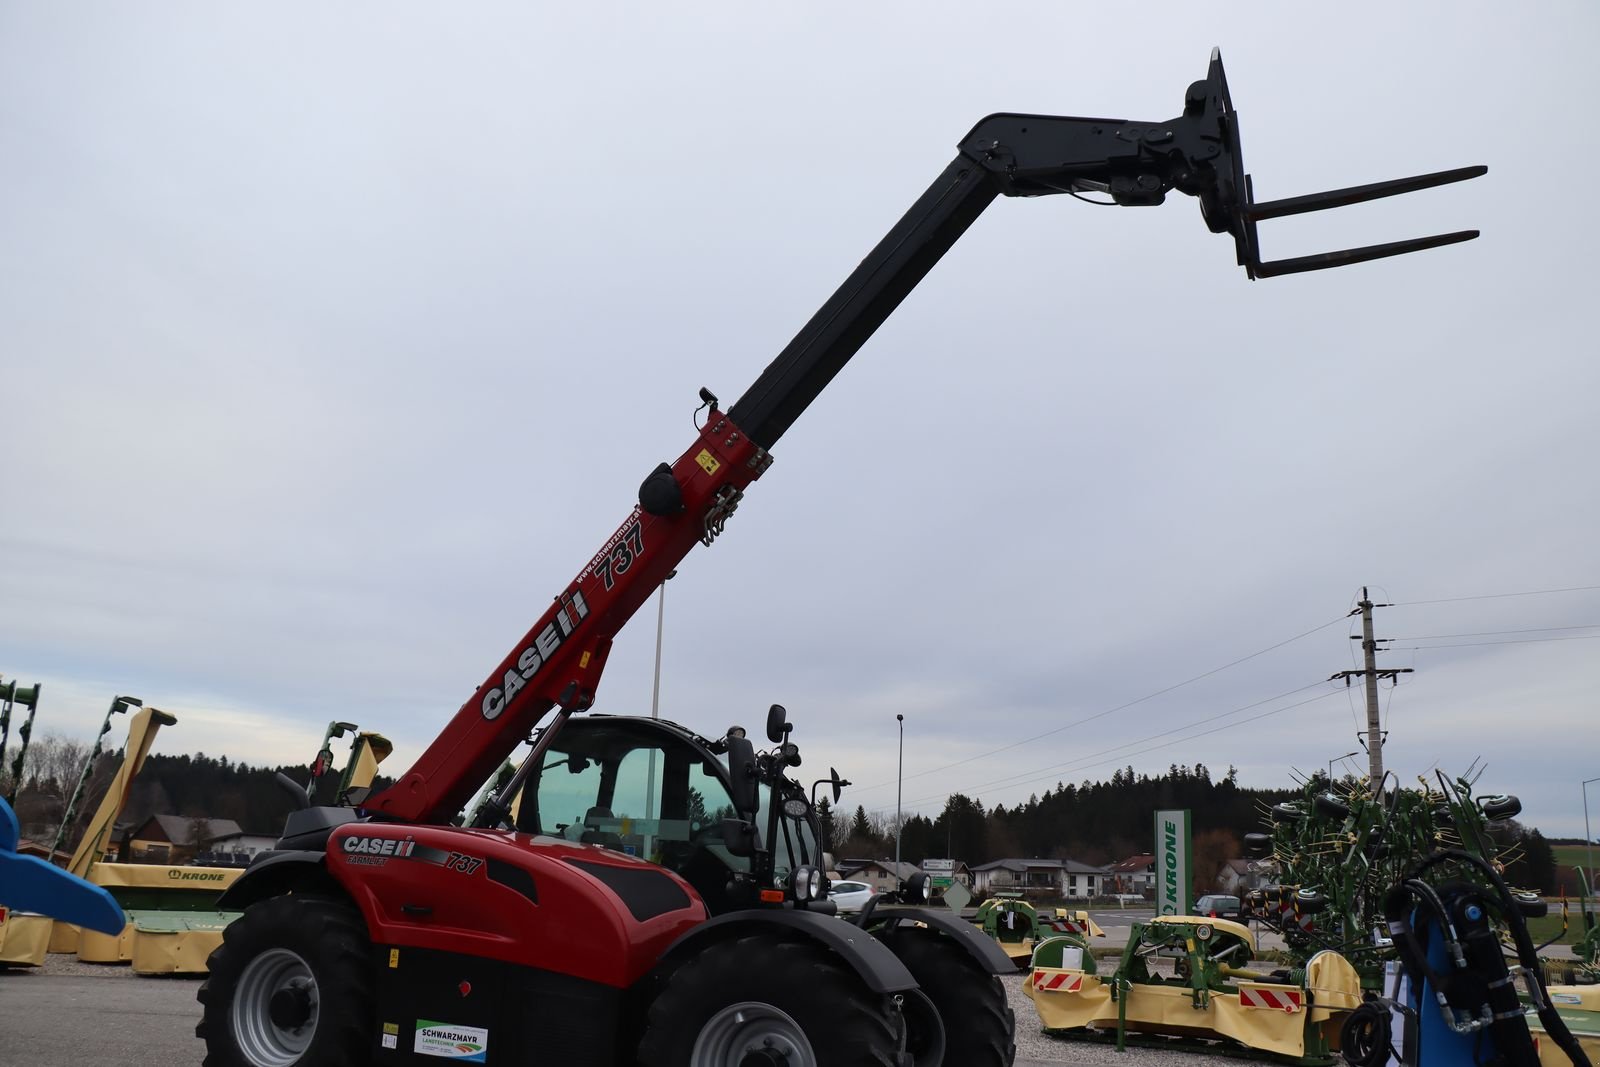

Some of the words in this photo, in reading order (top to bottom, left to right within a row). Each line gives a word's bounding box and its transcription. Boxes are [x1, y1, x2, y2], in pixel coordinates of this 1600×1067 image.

[576, 507, 642, 584] www.schwarzmayr.at
[594, 520, 645, 592] 737
[482, 622, 561, 720] CASE
[343, 836, 397, 855] CASE
[346, 855, 388, 867] FARMLIFT
[447, 852, 483, 876] 737
[1165, 820, 1177, 903] KRONE
[181, 872, 225, 881] KRONE
[422, 1029, 478, 1043] SCHWARZMAYR
